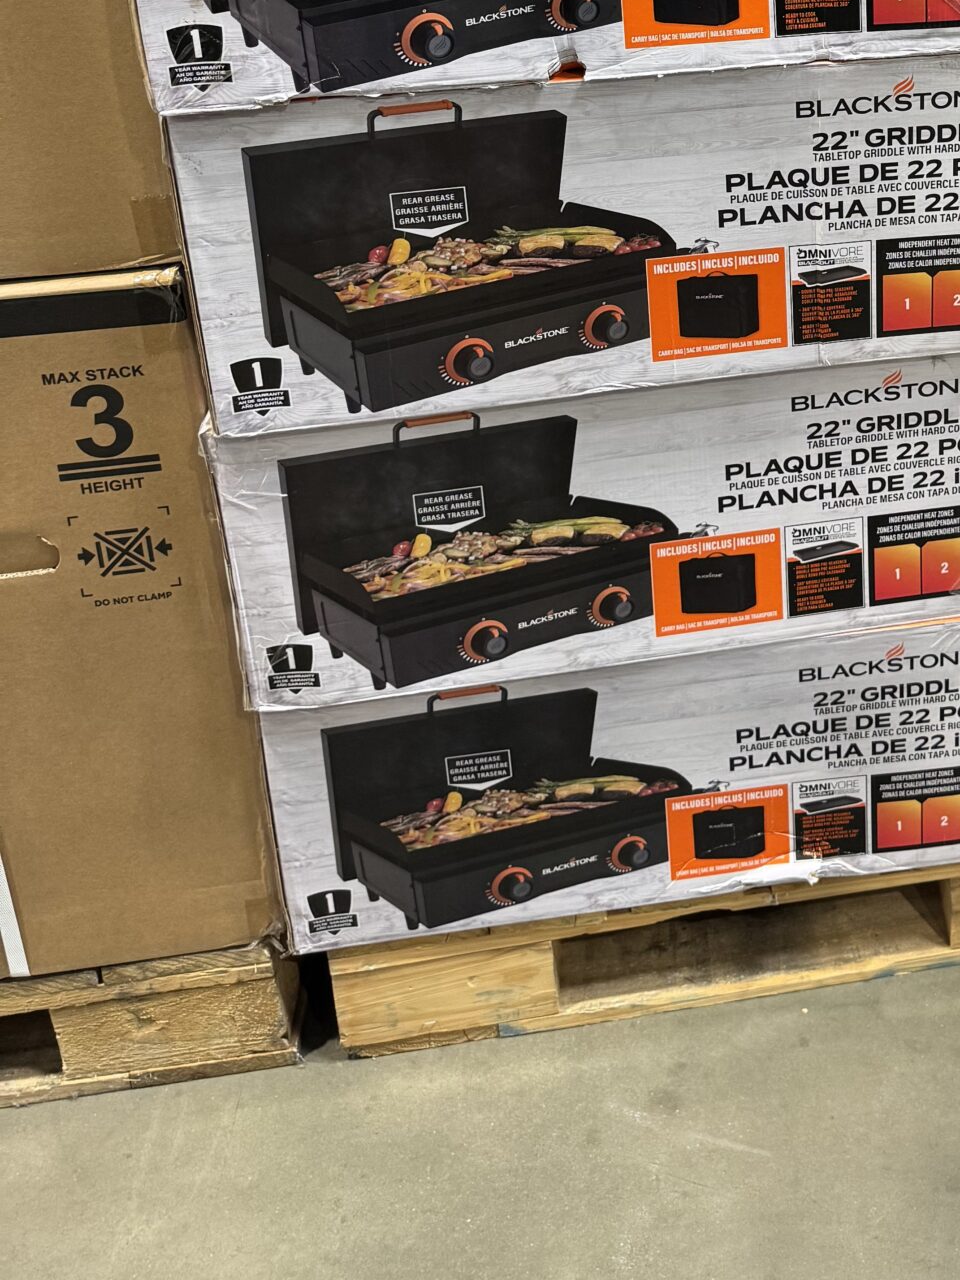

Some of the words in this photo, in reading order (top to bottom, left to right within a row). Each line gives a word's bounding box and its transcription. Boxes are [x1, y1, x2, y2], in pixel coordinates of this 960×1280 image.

[812, 130, 859, 152] 22"
[725, 165, 850, 193] PLAQUE
[859, 162, 899, 183] DE
[908, 159, 943, 179] 22
[718, 199, 868, 228] PLANCHA
[877, 195, 916, 216] DE
[925, 192, 959, 212] 22
[41, 370, 81, 386] MAX
[86, 365, 144, 381] STACK
[70, 384, 134, 458] 3
[807, 419, 851, 440] 22"
[725, 450, 842, 481] PLAQUE
[851, 445, 888, 466] DE
[896, 441, 929, 460] 22
[80, 477, 145, 495] HEIGHT
[718, 480, 860, 513] PLANCHA
[868, 474, 904, 494] DE
[913, 470, 945, 489] 22
[94, 598, 110, 607] DO
[113, 595, 135, 605] NOT
[137, 591, 172, 602] CLAMP
[813, 689, 855, 707] 22"
[736, 717, 847, 744] PLAQUE
[856, 713, 891, 730] DE
[899, 708, 930, 726] 22
[729, 743, 864, 772] PLANCHA
[871, 738, 906, 756] DE
[914, 734, 945, 752] 22
